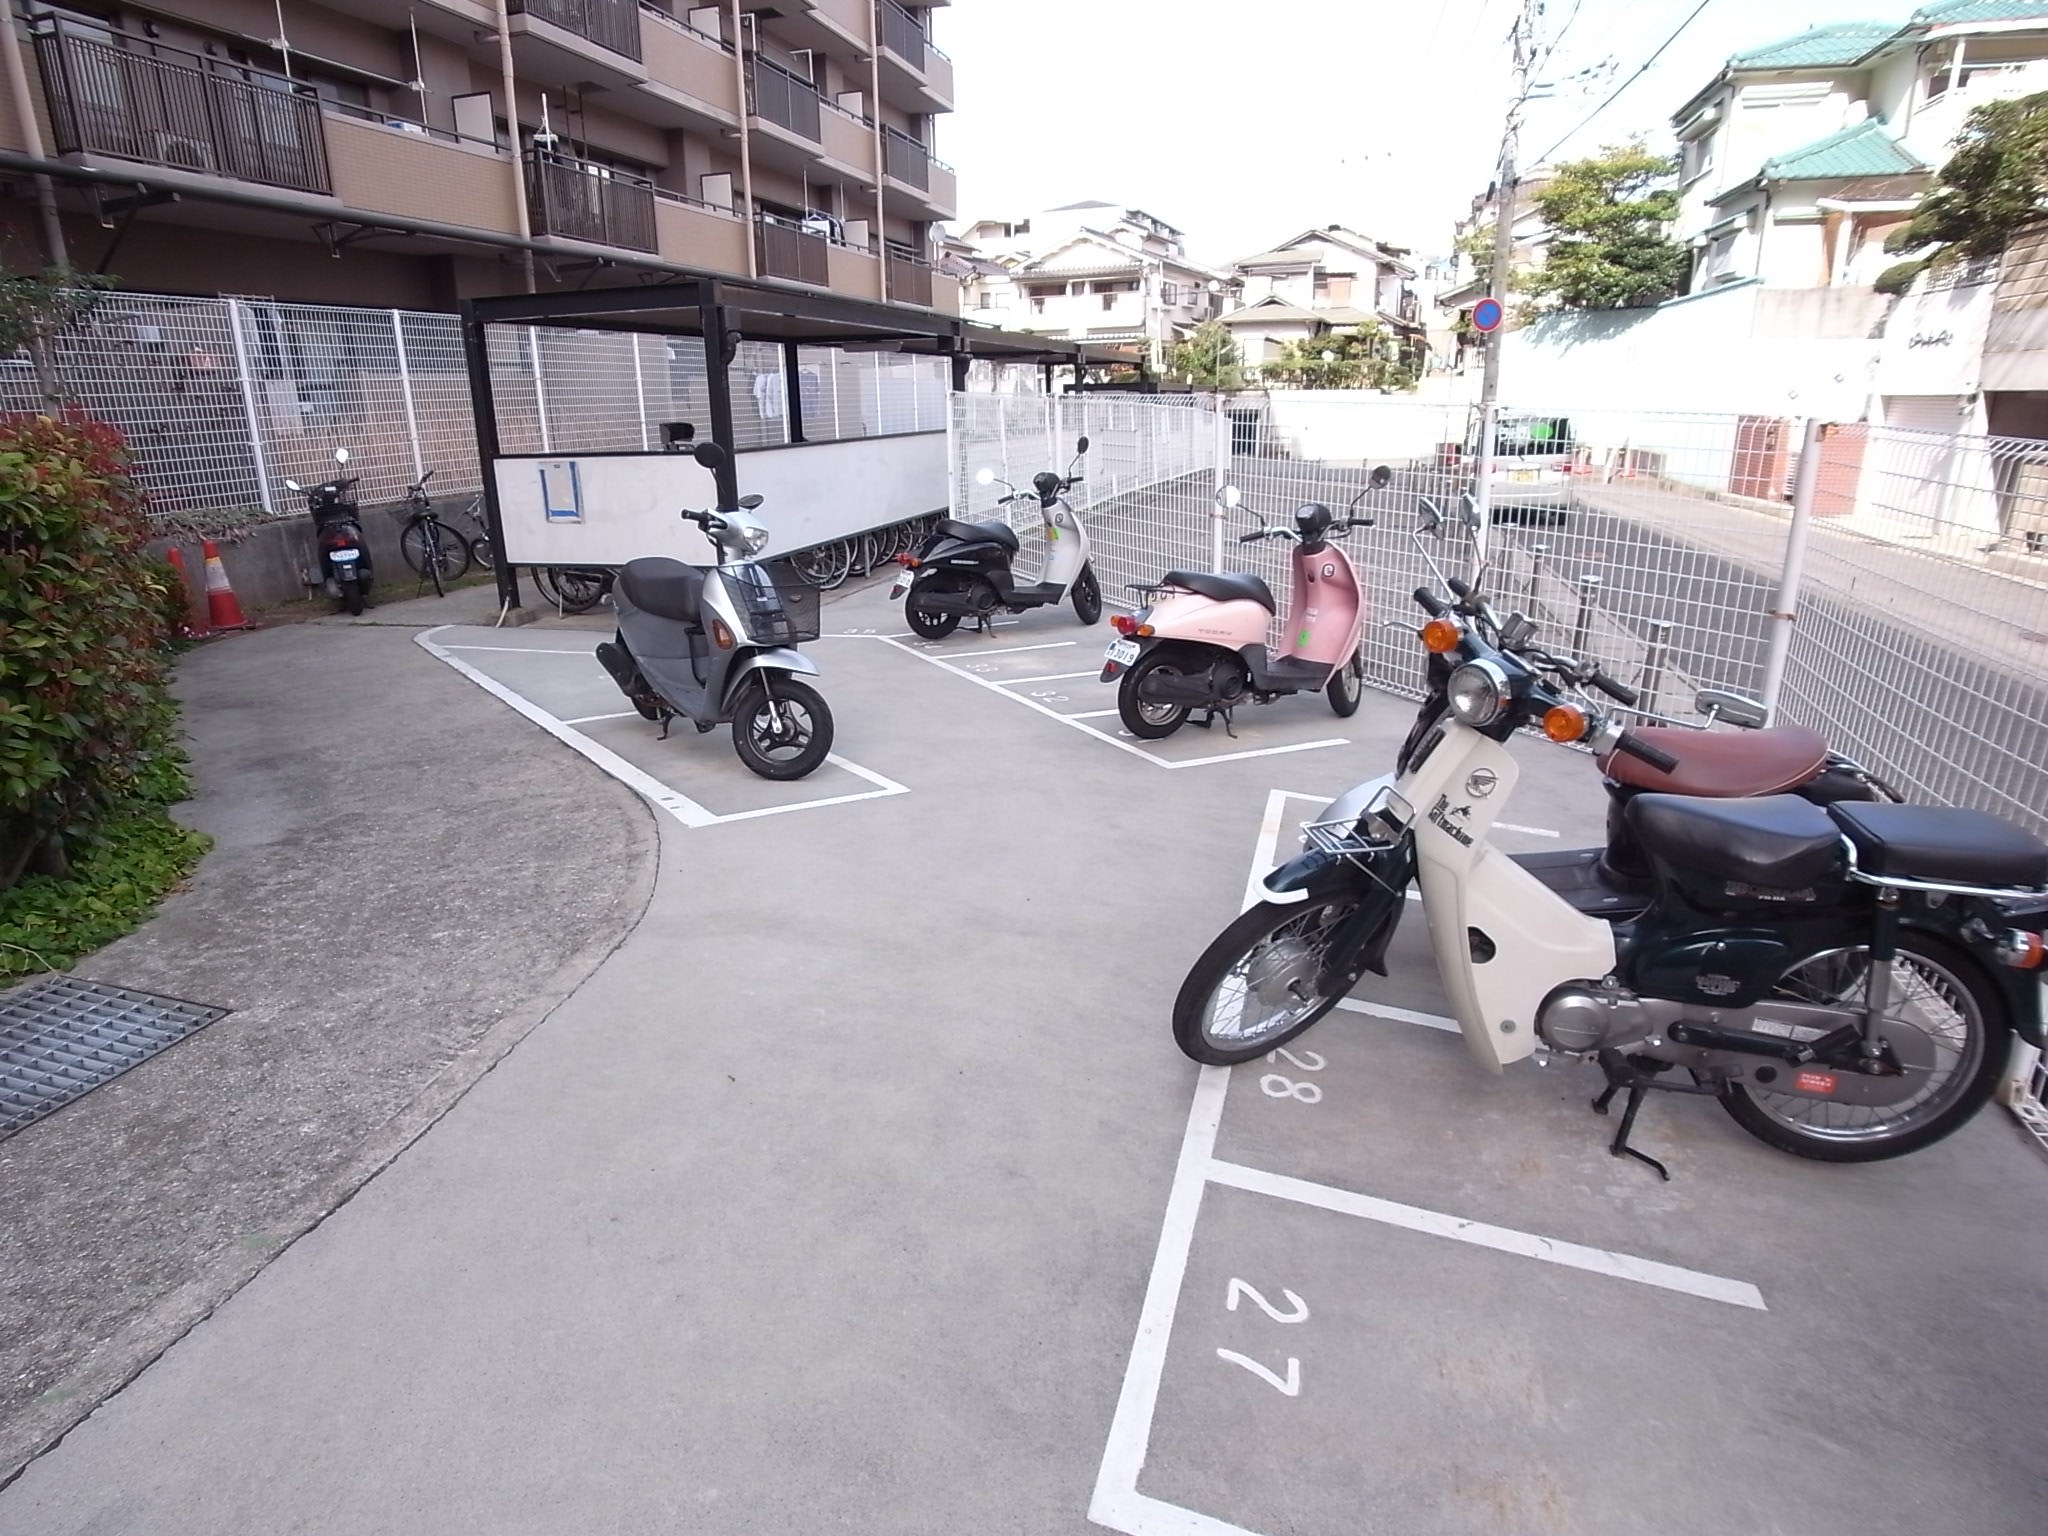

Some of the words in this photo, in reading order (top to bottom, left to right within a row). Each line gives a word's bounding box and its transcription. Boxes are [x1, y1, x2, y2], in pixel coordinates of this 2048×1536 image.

[1198, 628, 1233, 636] TODAY
[1260, 1047, 1325, 1104] 28
[1217, 1278, 1309, 1396] 27
